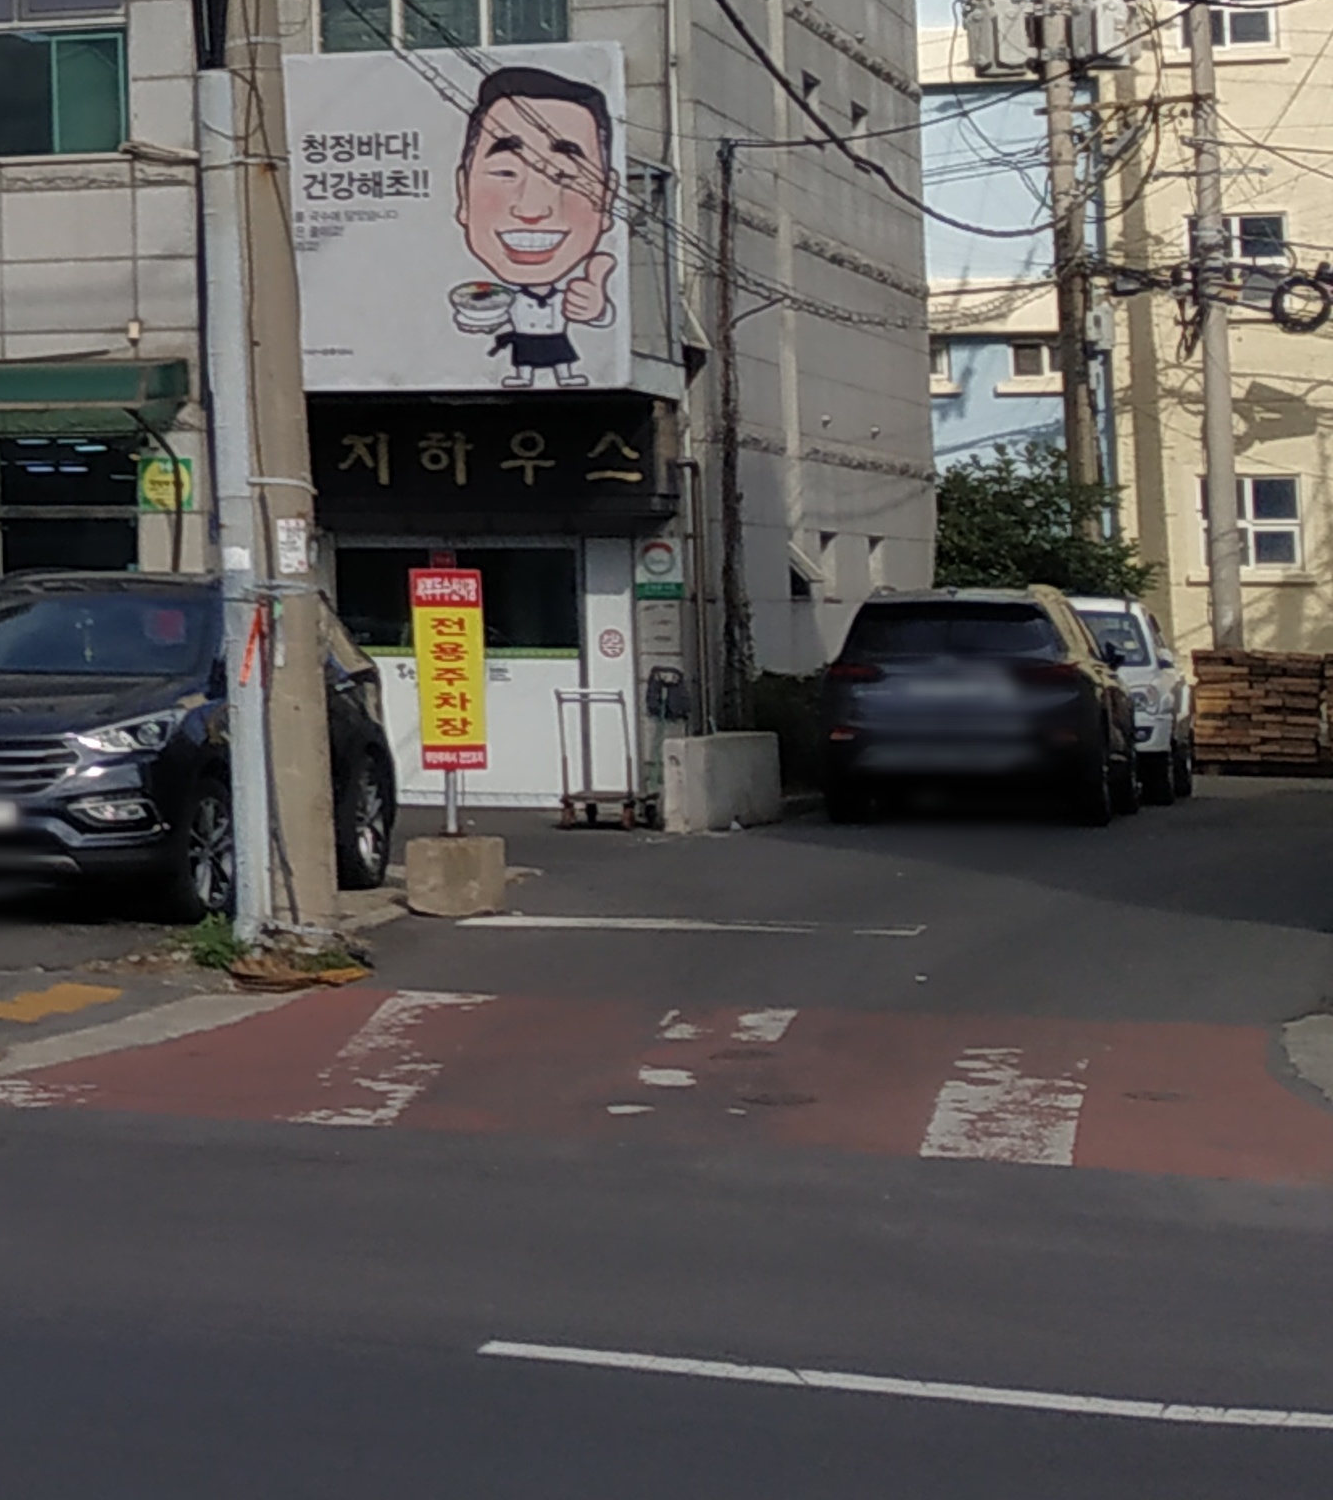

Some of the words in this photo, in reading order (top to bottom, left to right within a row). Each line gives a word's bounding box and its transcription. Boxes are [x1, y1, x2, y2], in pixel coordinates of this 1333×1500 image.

[301, 131, 421, 163] 청정바다!
[301, 169, 431, 200] 건강해초!!
[429, 616, 474, 737] 전용주차장
